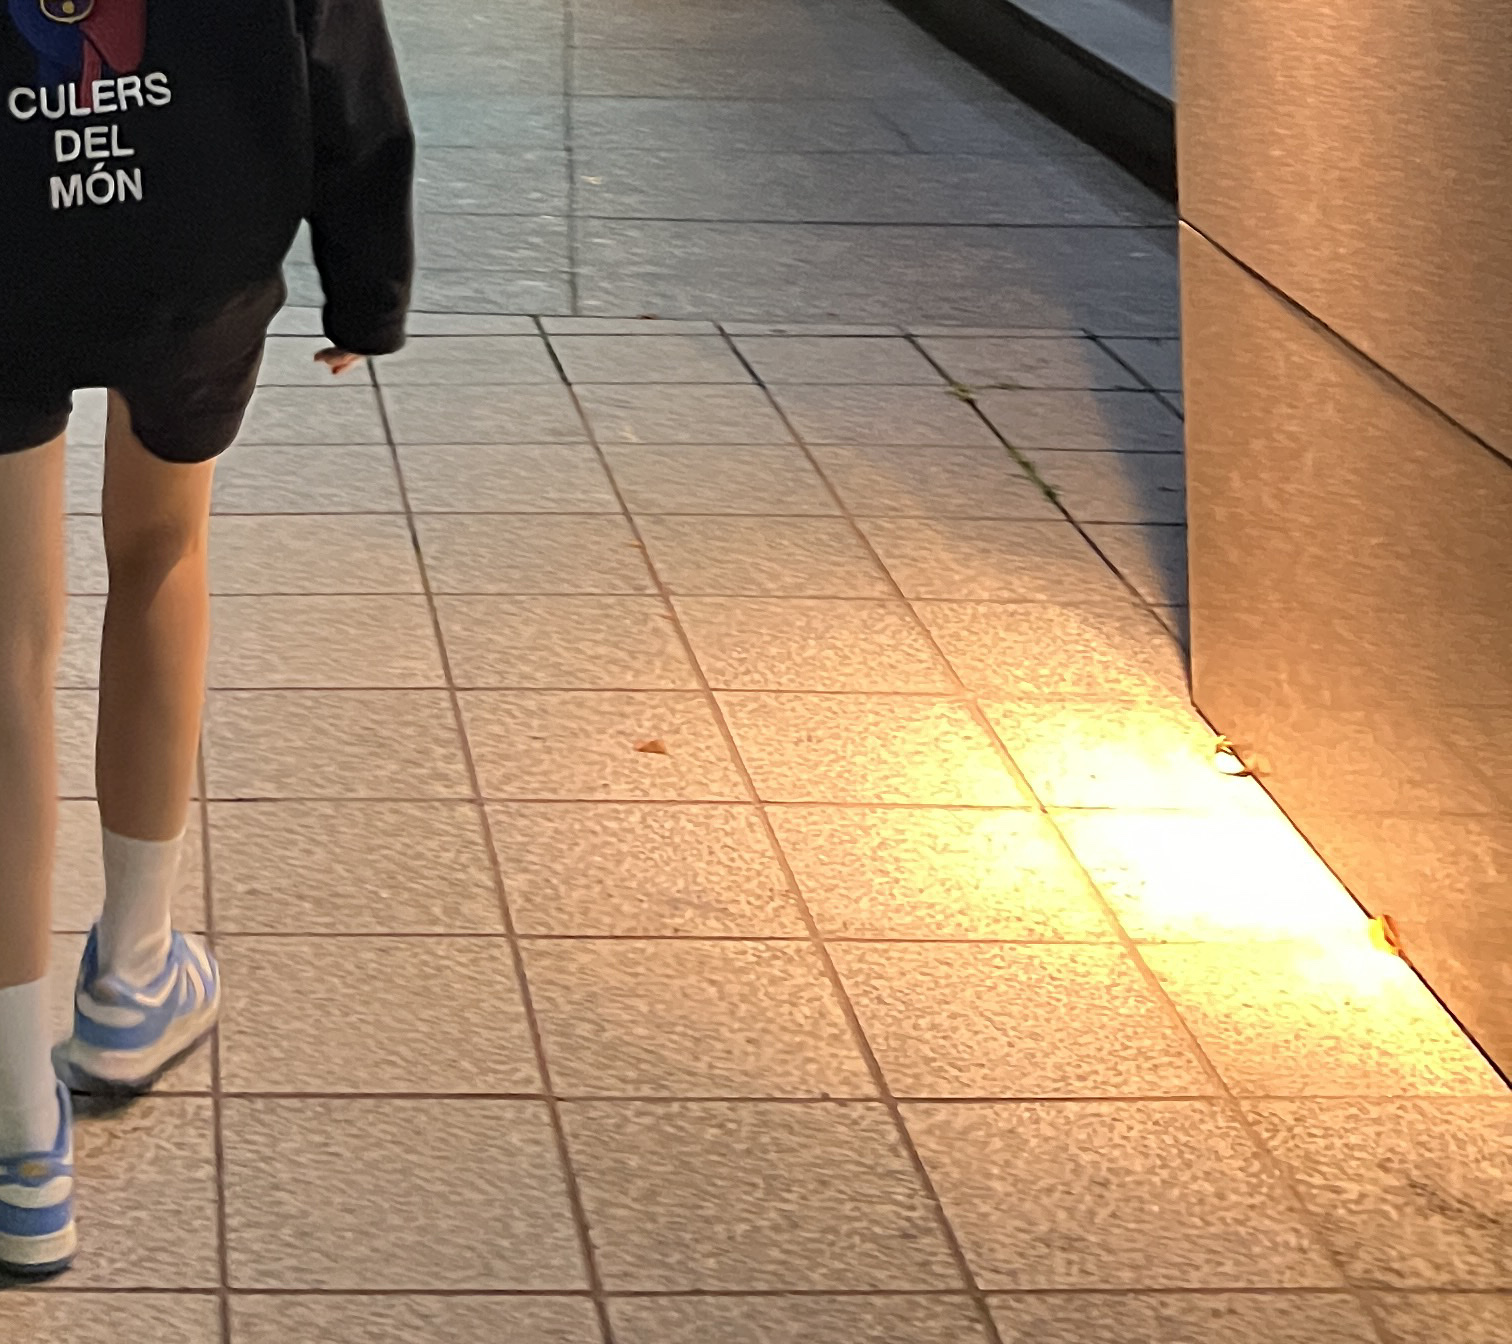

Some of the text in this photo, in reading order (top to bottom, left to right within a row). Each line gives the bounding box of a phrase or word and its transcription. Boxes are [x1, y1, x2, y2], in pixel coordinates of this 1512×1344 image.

[7, 71, 172, 121] CULERS
[54, 124, 136, 163] DEL
[49, 161, 143, 209] MÓN
